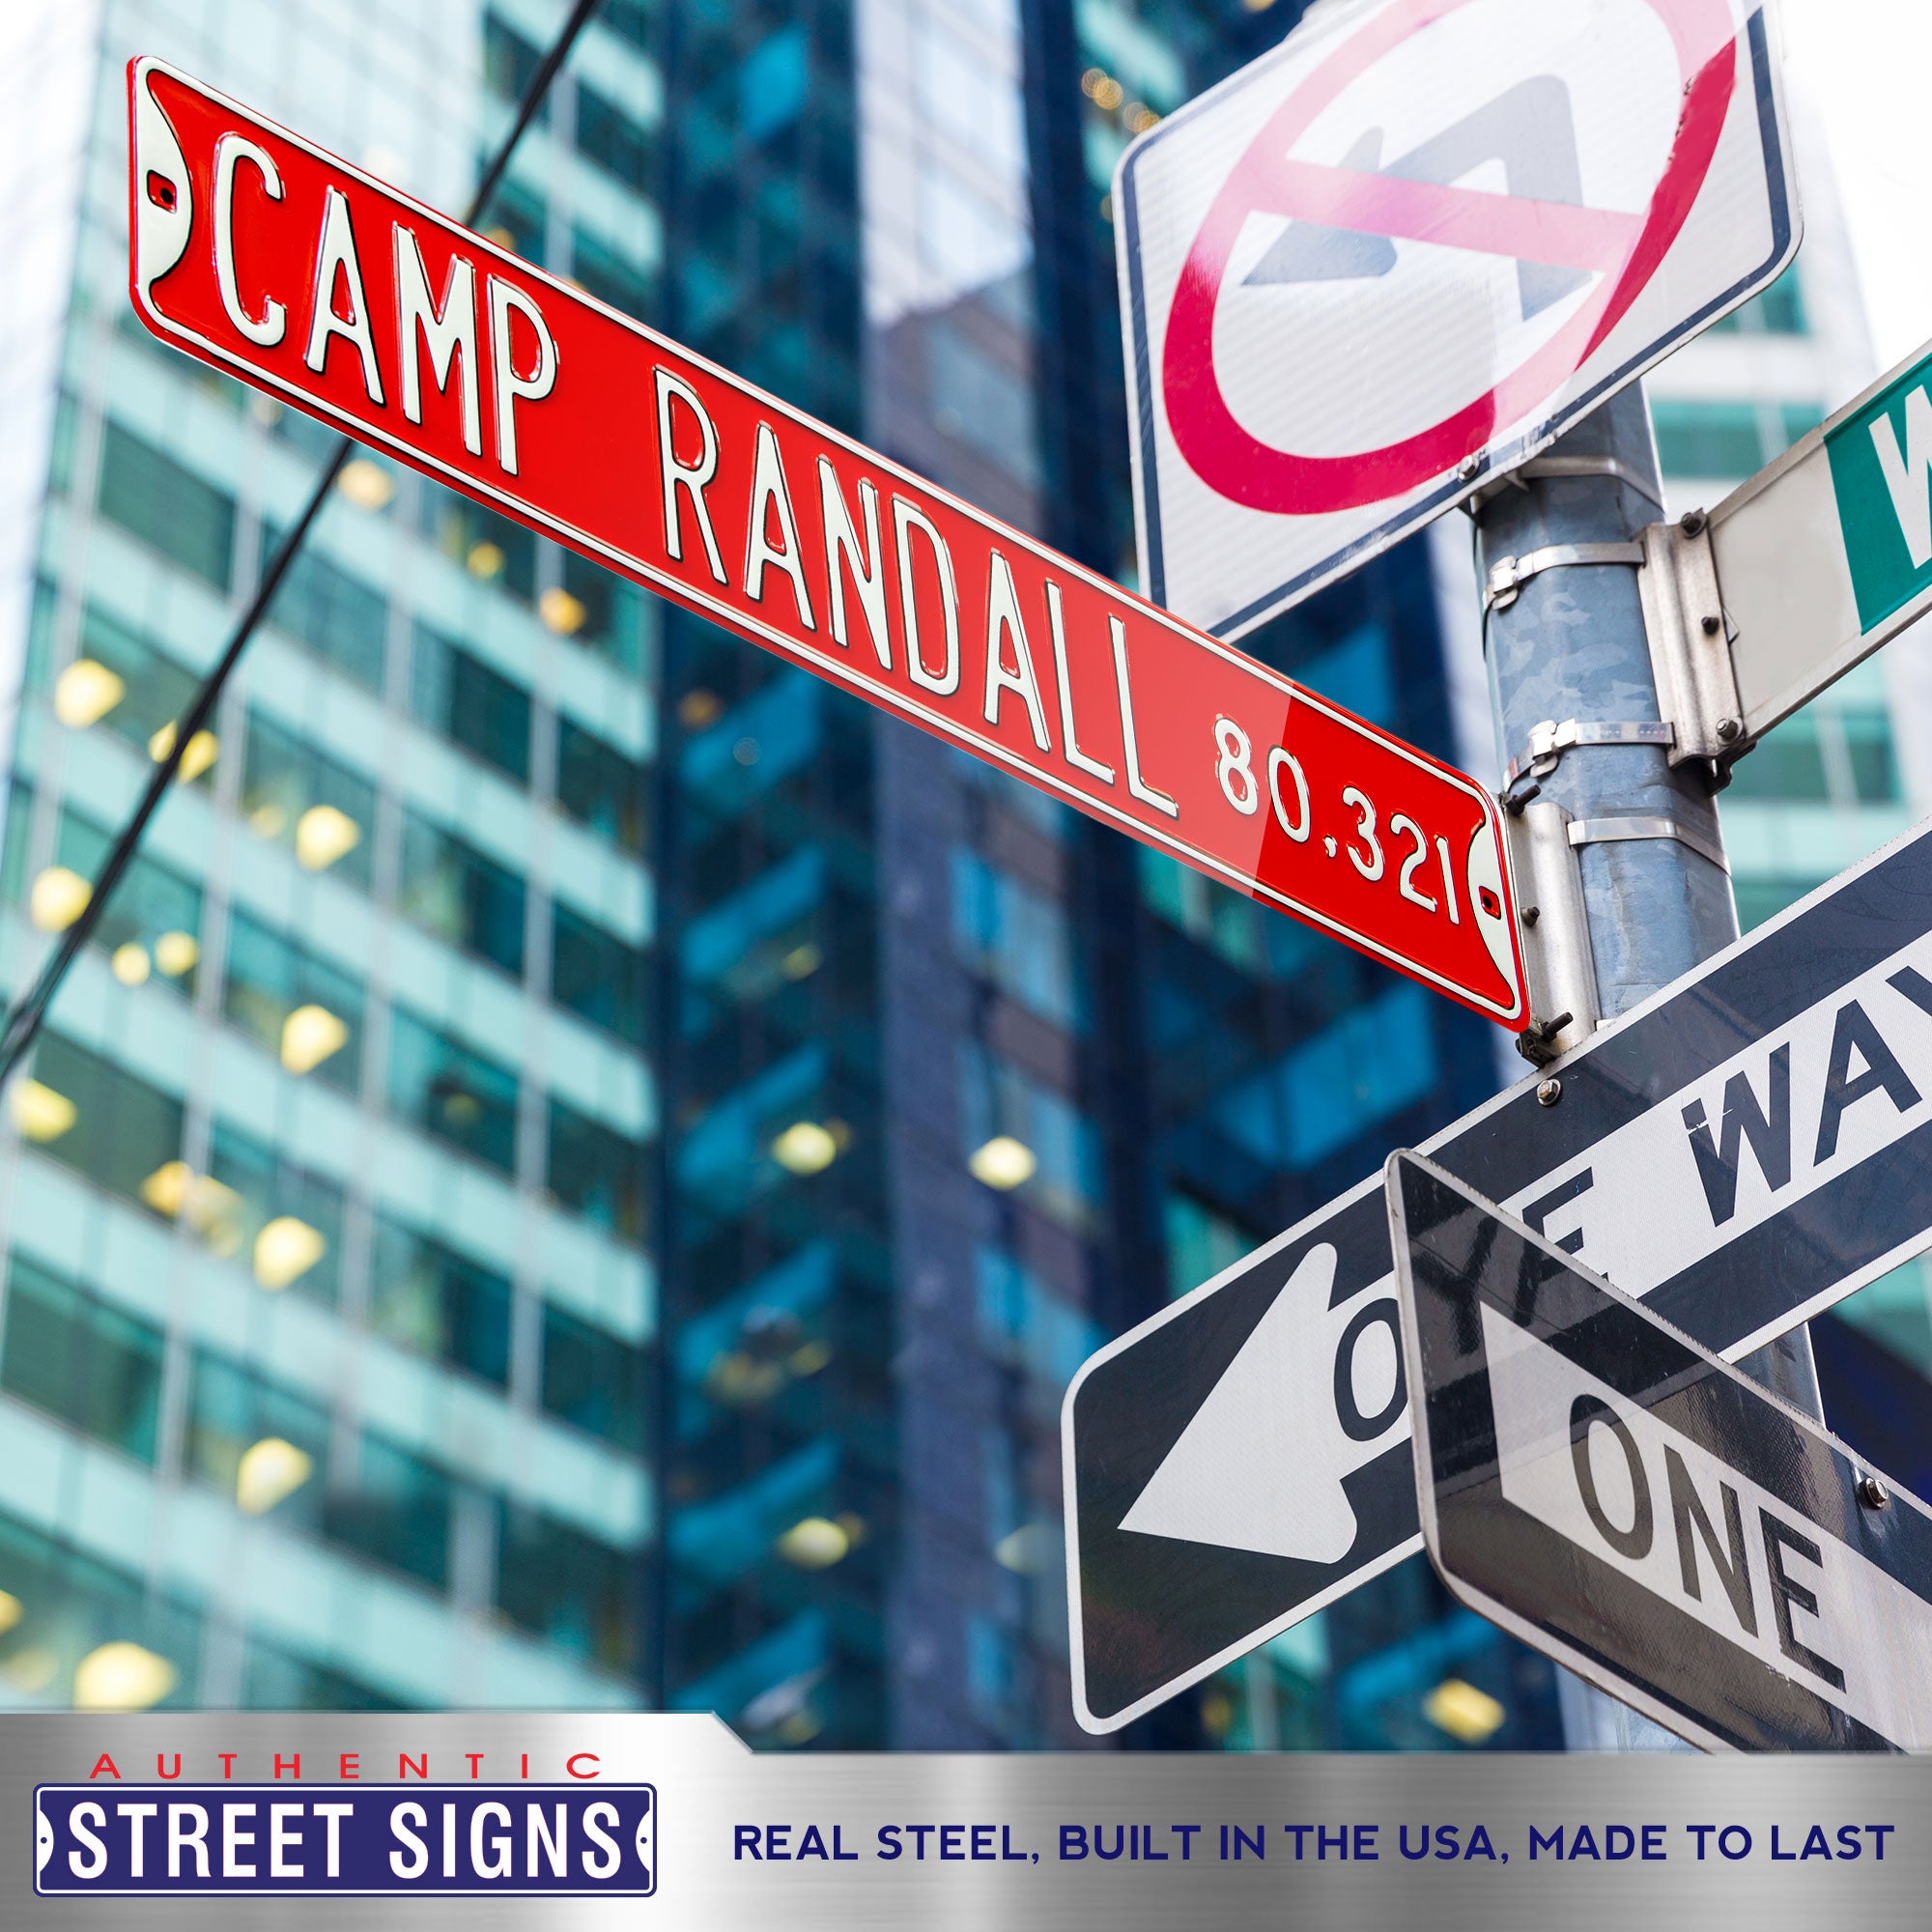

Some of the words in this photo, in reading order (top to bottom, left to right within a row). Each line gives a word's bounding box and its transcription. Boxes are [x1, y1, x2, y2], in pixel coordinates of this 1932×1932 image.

[213, 131, 560, 477] CAMP
[652, 364, 1179, 820] RANDALL
[1569, 1393, 1847, 1694] ONE
